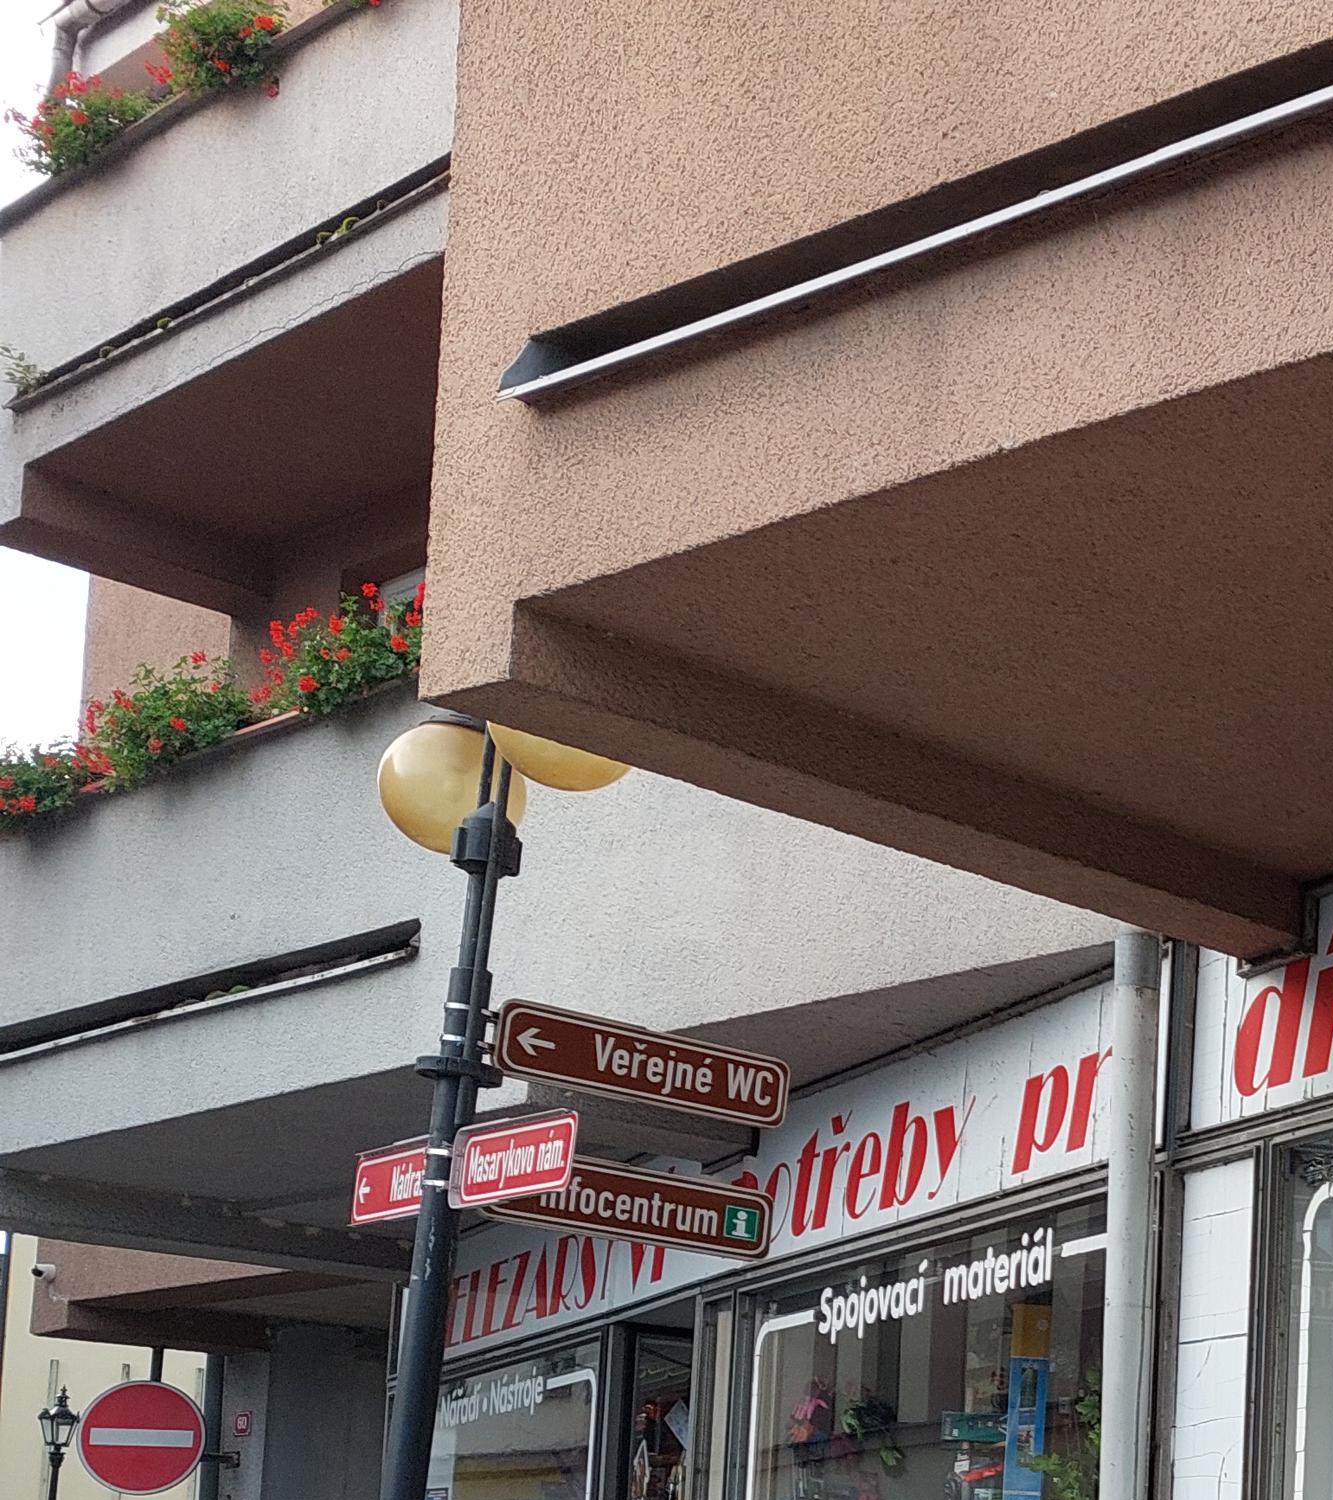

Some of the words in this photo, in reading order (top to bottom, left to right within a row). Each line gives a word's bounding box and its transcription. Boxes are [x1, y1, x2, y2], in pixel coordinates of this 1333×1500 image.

[594, 1033, 713, 1096] Veřejné
[727, 1061, 775, 1107] WC
[467, 1139, 535, 1189] Masarykovo
[536, 1130, 565, 1173] nám.
[731, 1094, 977, 1244] otřeby
[818, 1259, 928, 1344] Spojovací
[943, 1226, 1054, 1306] materiál
[439, 1383, 482, 1429] Nářadí
[489, 1366, 544, 1416] Nástroje
